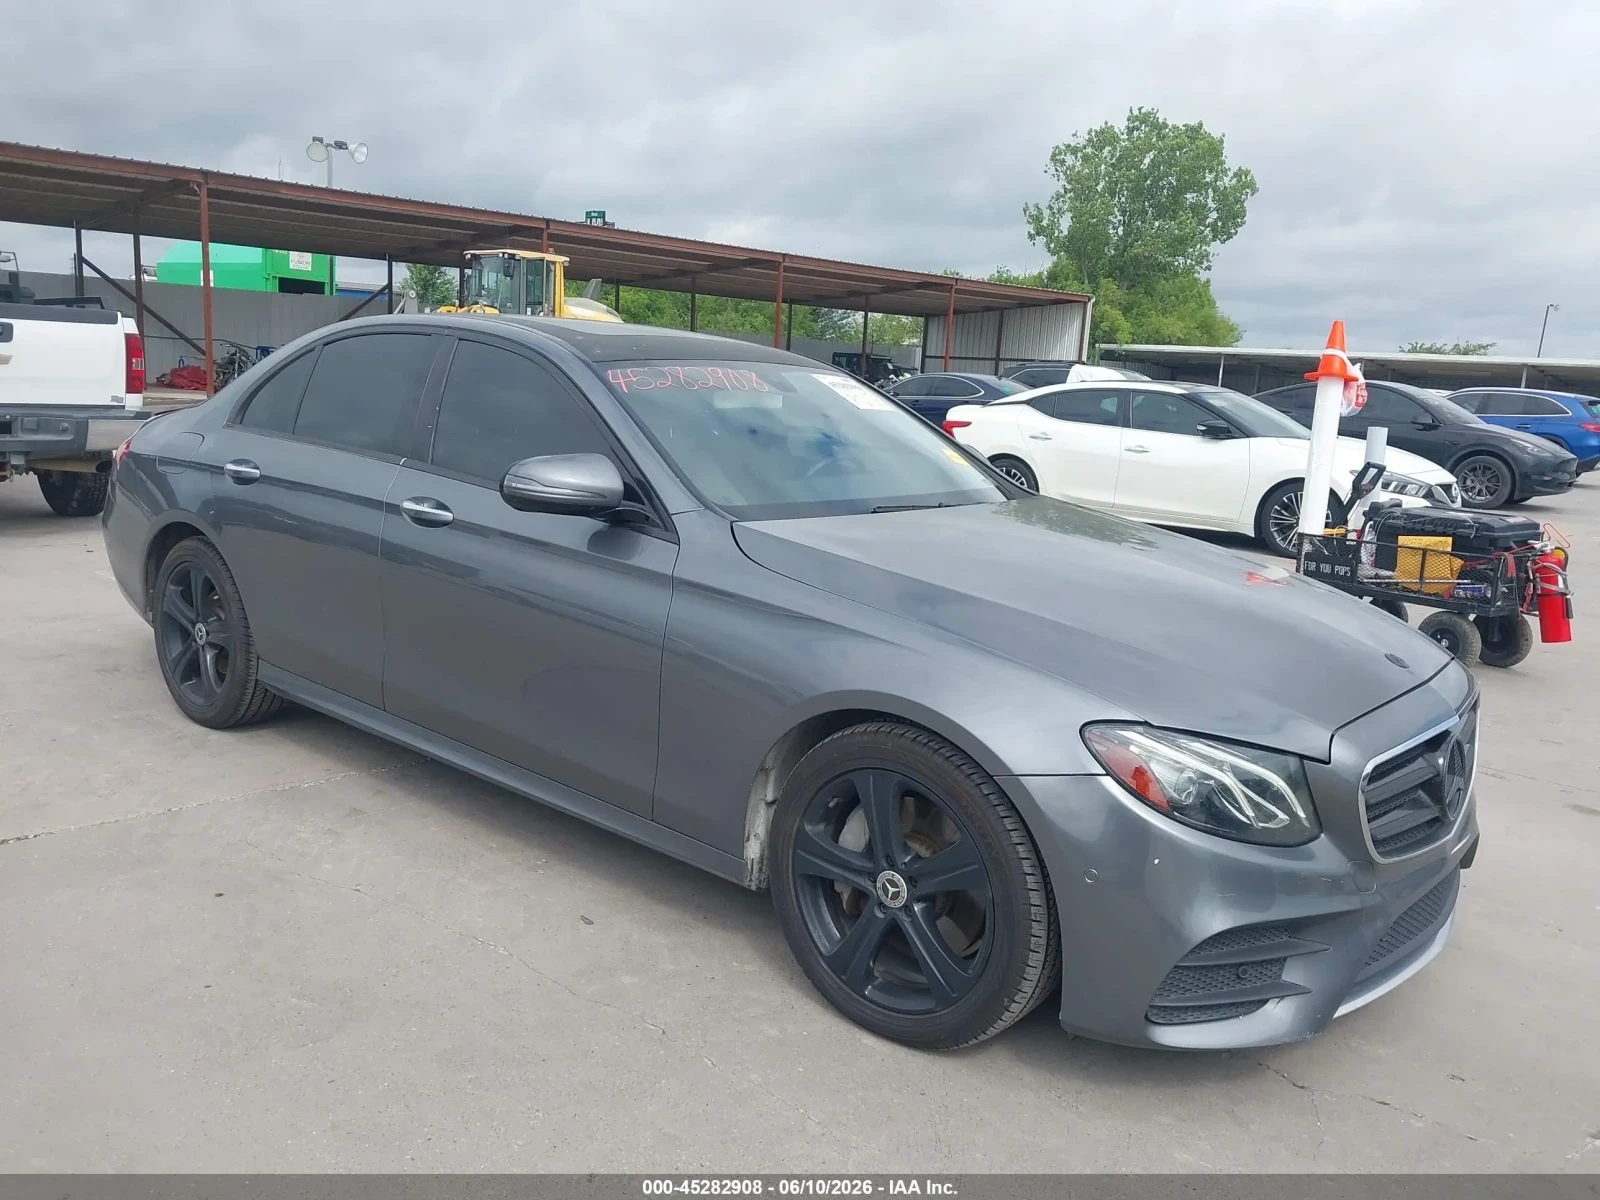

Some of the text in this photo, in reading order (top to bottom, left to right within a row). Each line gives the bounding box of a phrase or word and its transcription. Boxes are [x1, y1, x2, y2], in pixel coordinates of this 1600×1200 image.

[607, 366, 769, 394] 45282908
[1304, 561, 1351, 576] FOR YOU POPS
